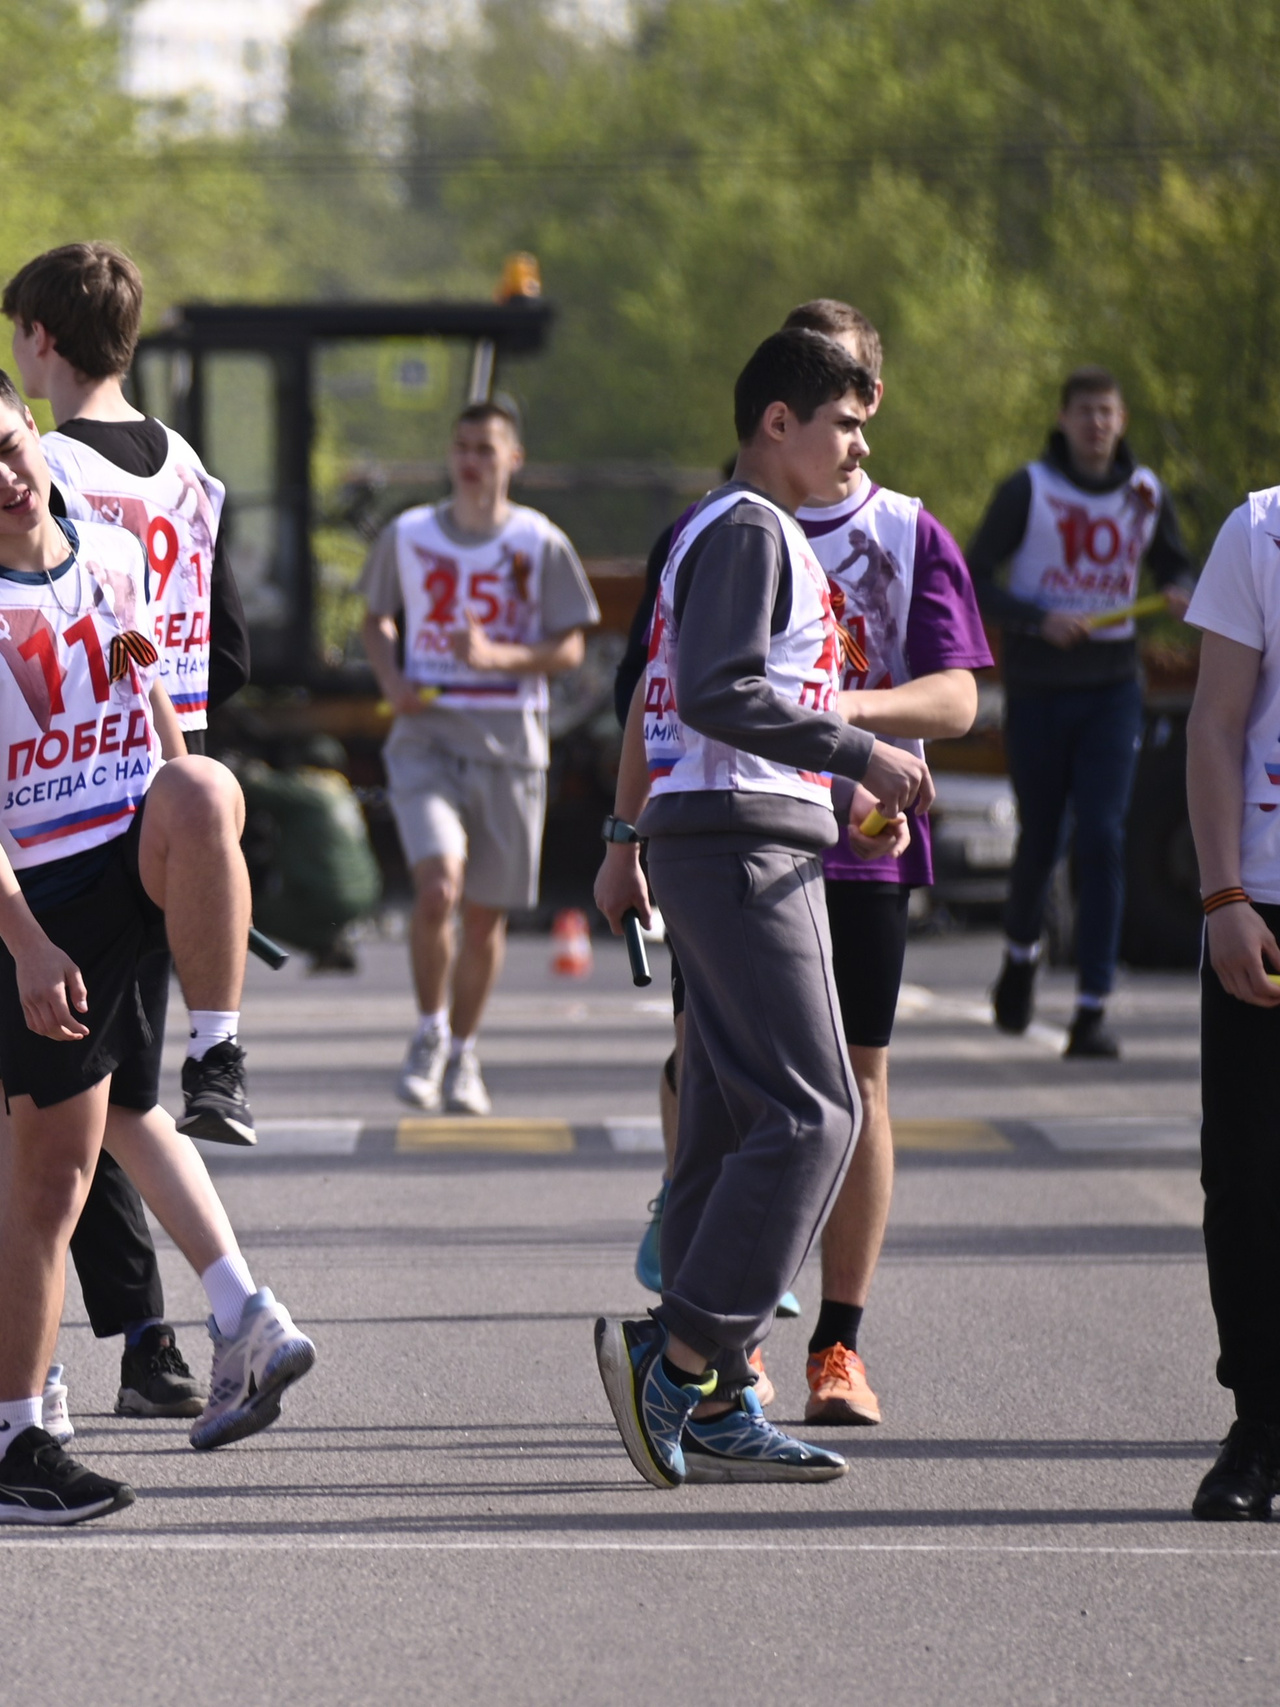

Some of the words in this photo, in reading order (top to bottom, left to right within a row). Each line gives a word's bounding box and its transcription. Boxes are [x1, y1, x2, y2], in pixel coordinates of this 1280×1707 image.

[146, 516, 179, 601] 9
[1056, 516, 1121, 571] 10
[424, 569, 501, 625] 25
[17, 614, 110, 716] 11
[92, 765, 107, 786] С
